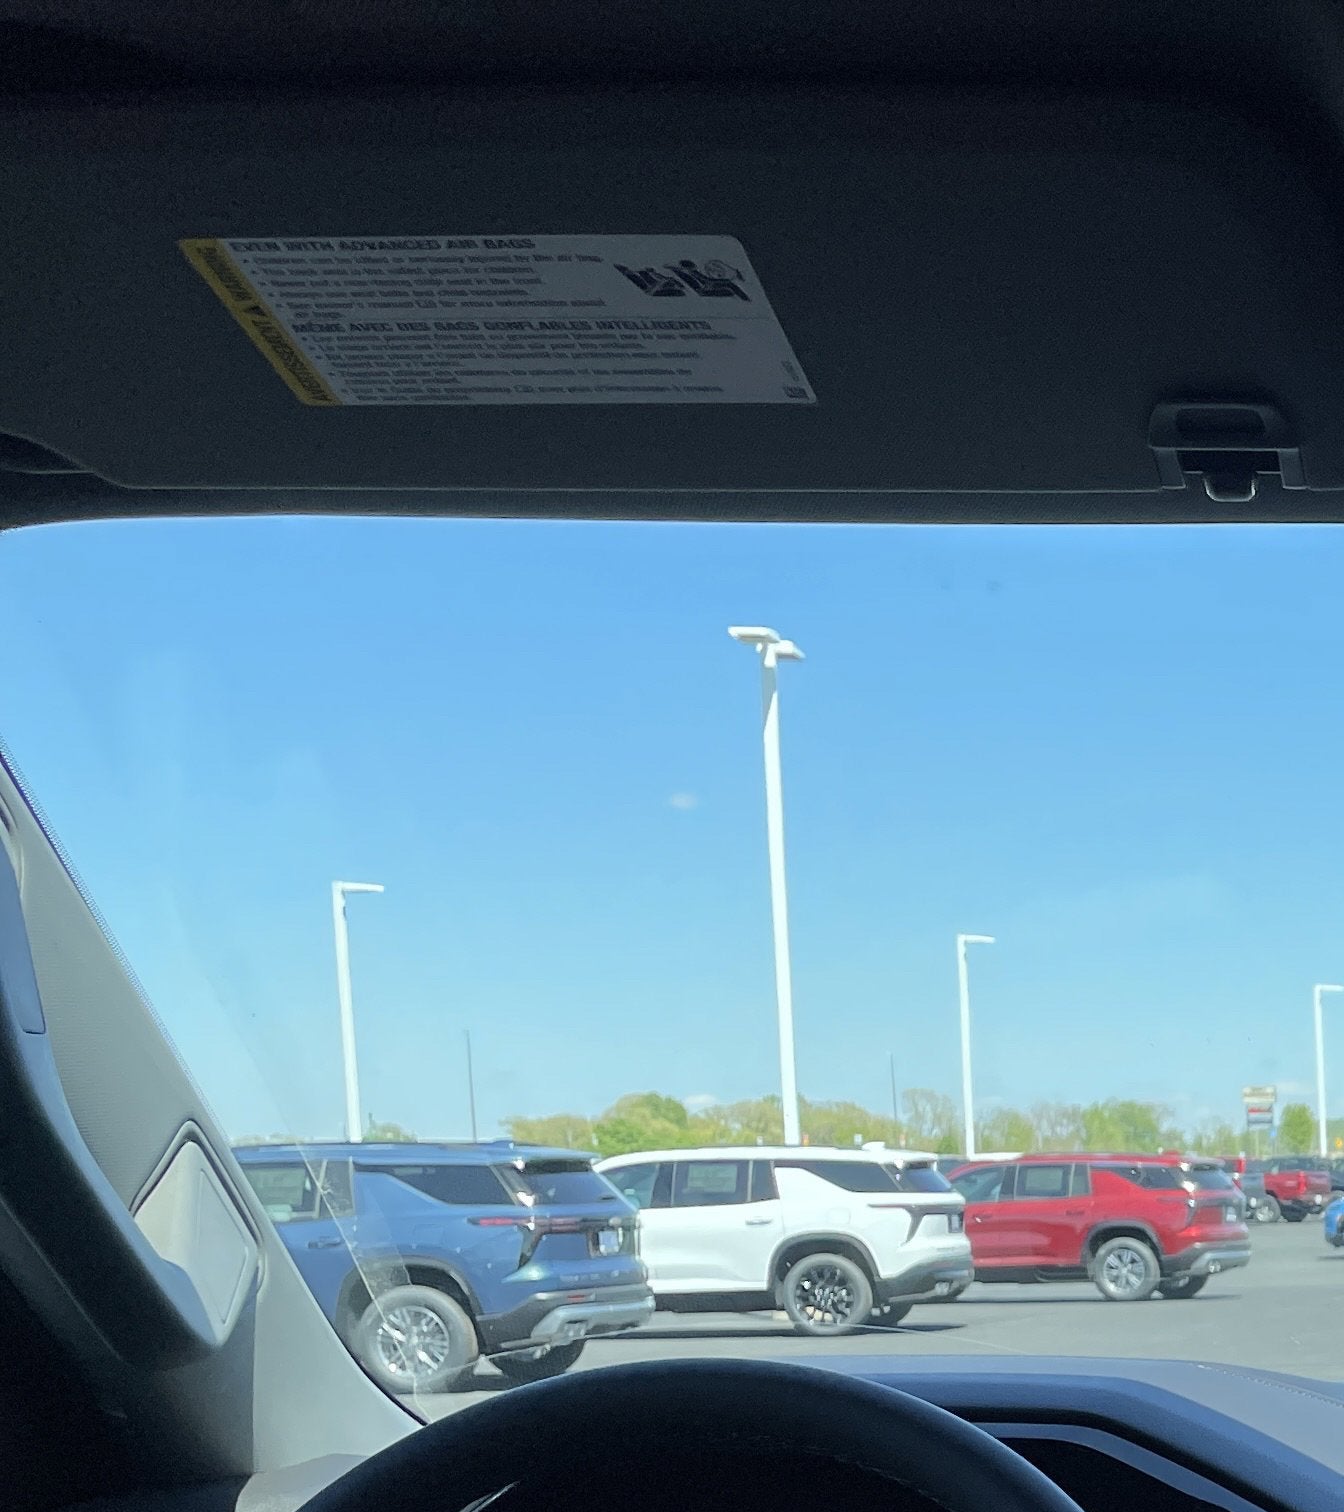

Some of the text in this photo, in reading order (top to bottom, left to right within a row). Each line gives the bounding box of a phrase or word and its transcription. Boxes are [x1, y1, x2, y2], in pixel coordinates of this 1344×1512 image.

[282, 241, 335, 251] WITH
[338, 240, 441, 251] ADVANCED
[484, 239, 536, 250] BAGS
[350, 321, 393, 332] AVEC
[484, 320, 592, 331] GONFLABLES
